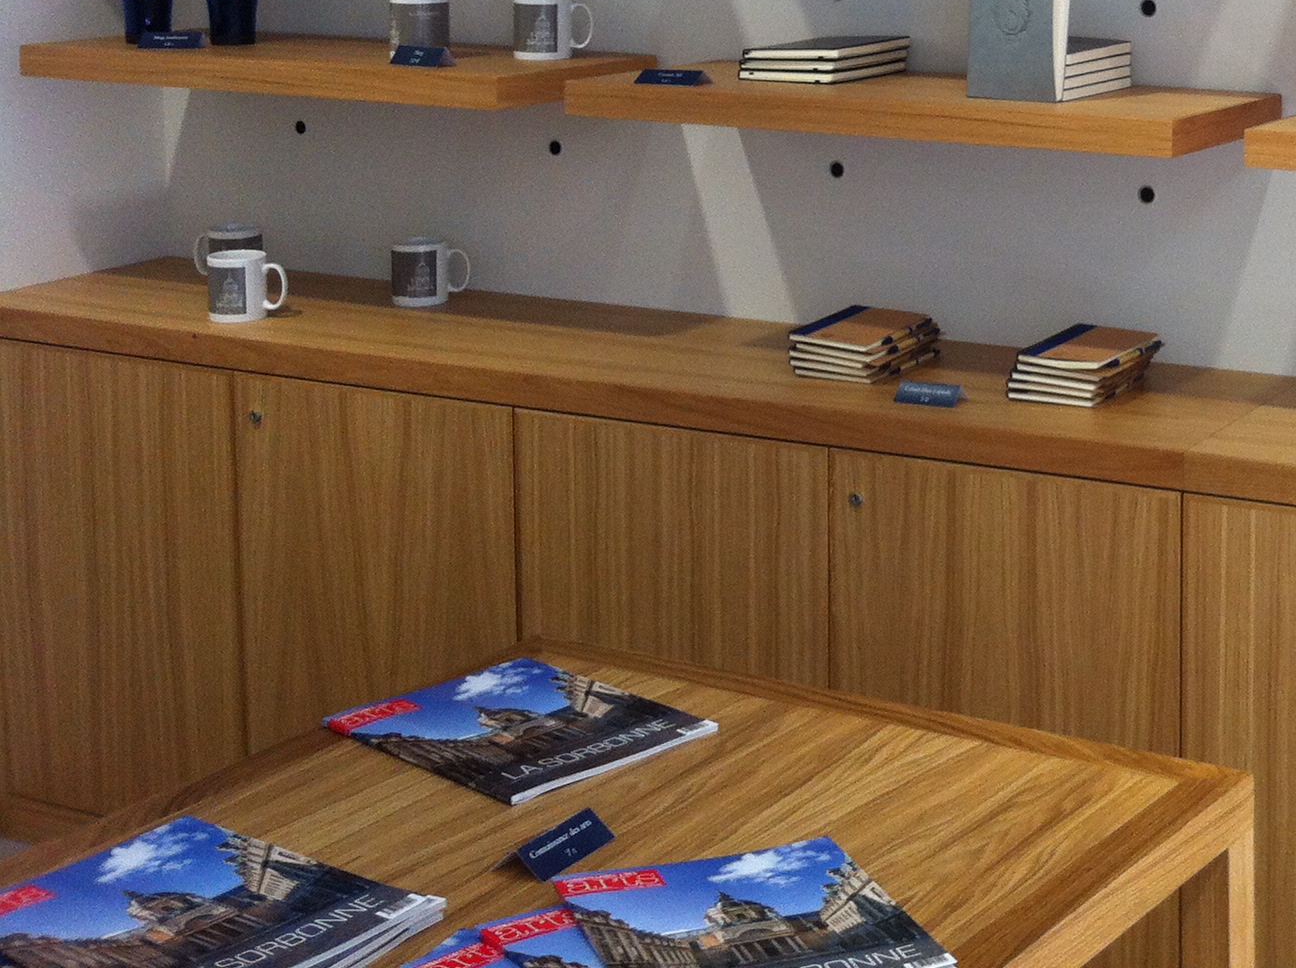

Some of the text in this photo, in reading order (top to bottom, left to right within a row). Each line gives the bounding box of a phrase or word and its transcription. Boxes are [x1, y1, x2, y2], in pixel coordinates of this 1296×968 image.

[501, 717, 677, 781] LA SORBONNE
[566, 872, 661, 895] arts
[213, 893, 385, 968] SORBONNE
